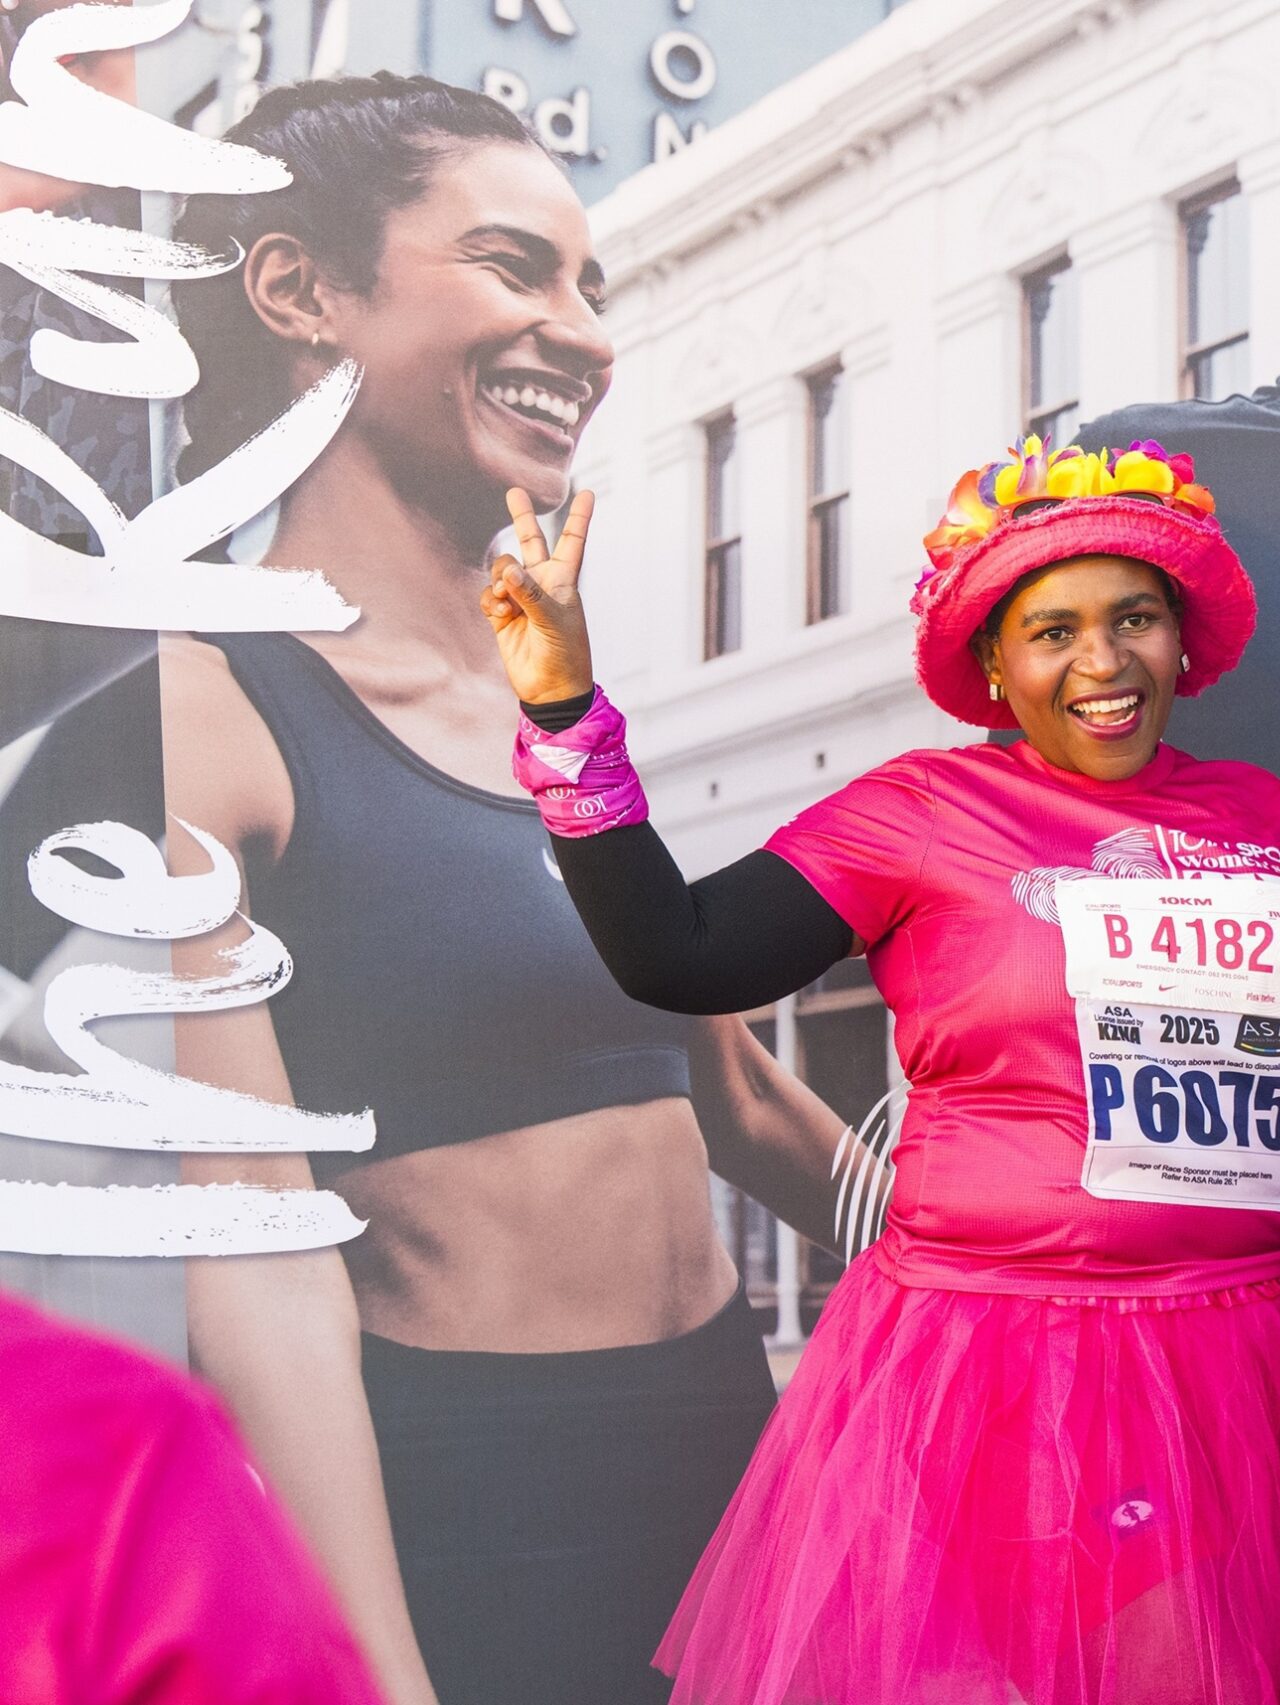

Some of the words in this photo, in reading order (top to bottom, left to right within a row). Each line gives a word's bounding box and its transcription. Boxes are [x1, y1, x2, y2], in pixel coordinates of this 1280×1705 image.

[0, 0, 366, 632] Run
[1157, 896, 1213, 906] 10KM
[1103, 914, 1133, 959] B
[1150, 915, 1274, 974] 4182
[1104, 1005, 1133, 1018] ASA
[1117, 1017, 1136, 1026] issued
[1136, 1019, 1144, 1028] by
[1160, 1013, 1220, 1045] 2025
[1097, 1022, 1142, 1045] KZNA
[1089, 1051, 1122, 1061] Covering
[1167, 1058, 1187, 1067] logos
[1188, 1059, 1211, 1067] above
[1227, 1060, 1244, 1068] lead
[1088, 1063, 1125, 1141] P
[1128, 1161, 1151, 1170] Image
[1162, 1164, 1182, 1173] Race
[1183, 1167, 1211, 1176] Sponsor
[1212, 1169, 1228, 1177] must
[1239, 1171, 1260, 1179] placed
[1161, 1172, 1182, 1181] Refer
[1183, 1174, 1190, 1182] to
[1208, 1176, 1223, 1185] Rule
[1224, 1178, 1238, 1186] 26.1
